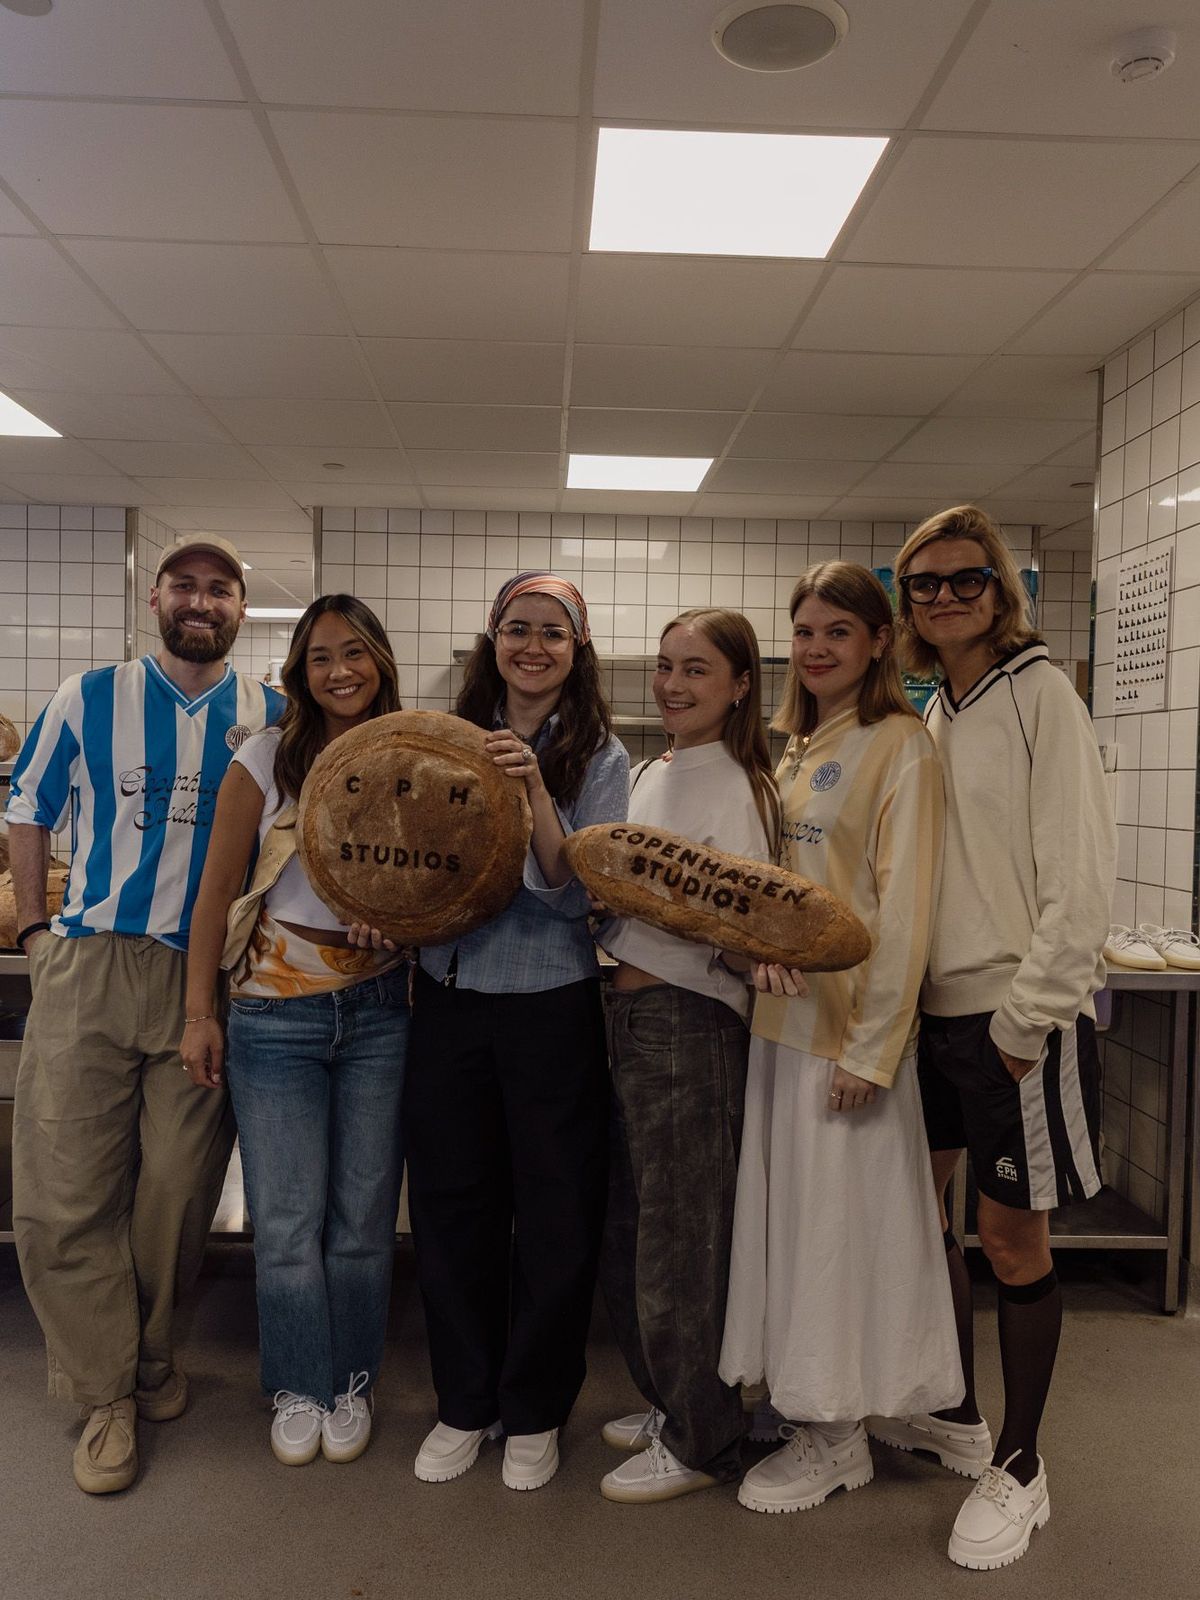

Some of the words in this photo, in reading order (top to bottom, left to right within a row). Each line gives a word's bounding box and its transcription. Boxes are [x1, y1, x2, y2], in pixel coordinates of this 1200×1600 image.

[346, 776, 361, 794] C
[396, 779, 412, 797] P
[449, 785, 469, 805] H
[340, 842, 461, 872] STUDIOS
[609, 828, 807, 905] COPENHAGEN
[630, 855, 750, 915] STUDIOS
[996, 1165, 1017, 1178] CPH
